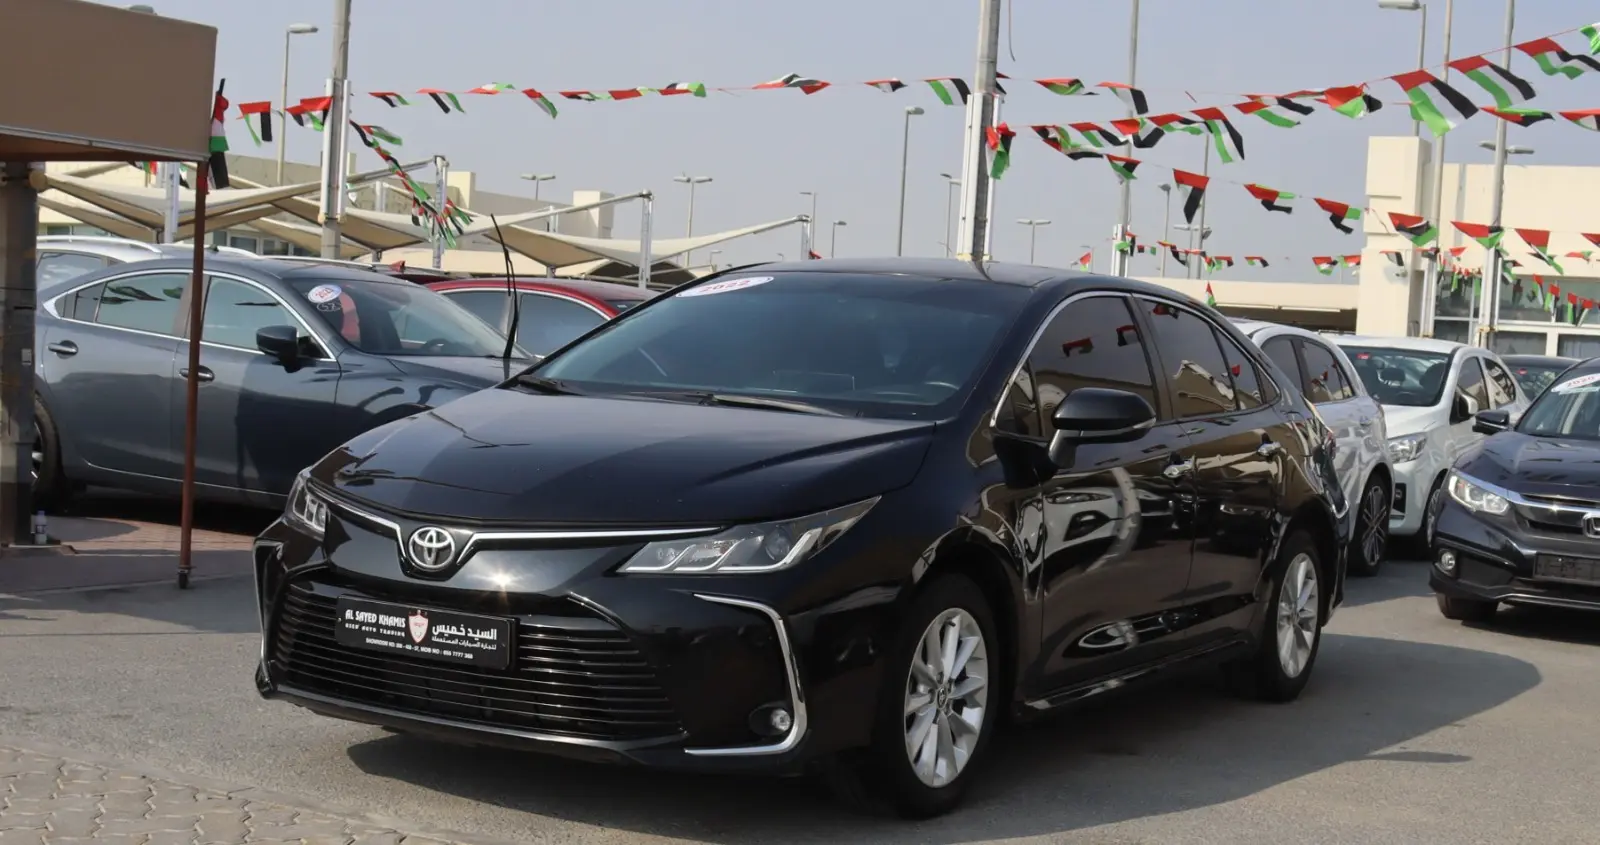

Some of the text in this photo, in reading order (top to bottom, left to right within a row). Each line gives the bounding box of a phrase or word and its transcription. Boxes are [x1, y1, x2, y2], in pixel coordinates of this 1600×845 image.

[345, 609, 406, 628] AL SAYED KHAMIS
[380, 628, 405, 637] TRADING
[432, 623, 497, 641] السيد خميس
[431, 635, 497, 651] لتجارة السيارات المستعملة
